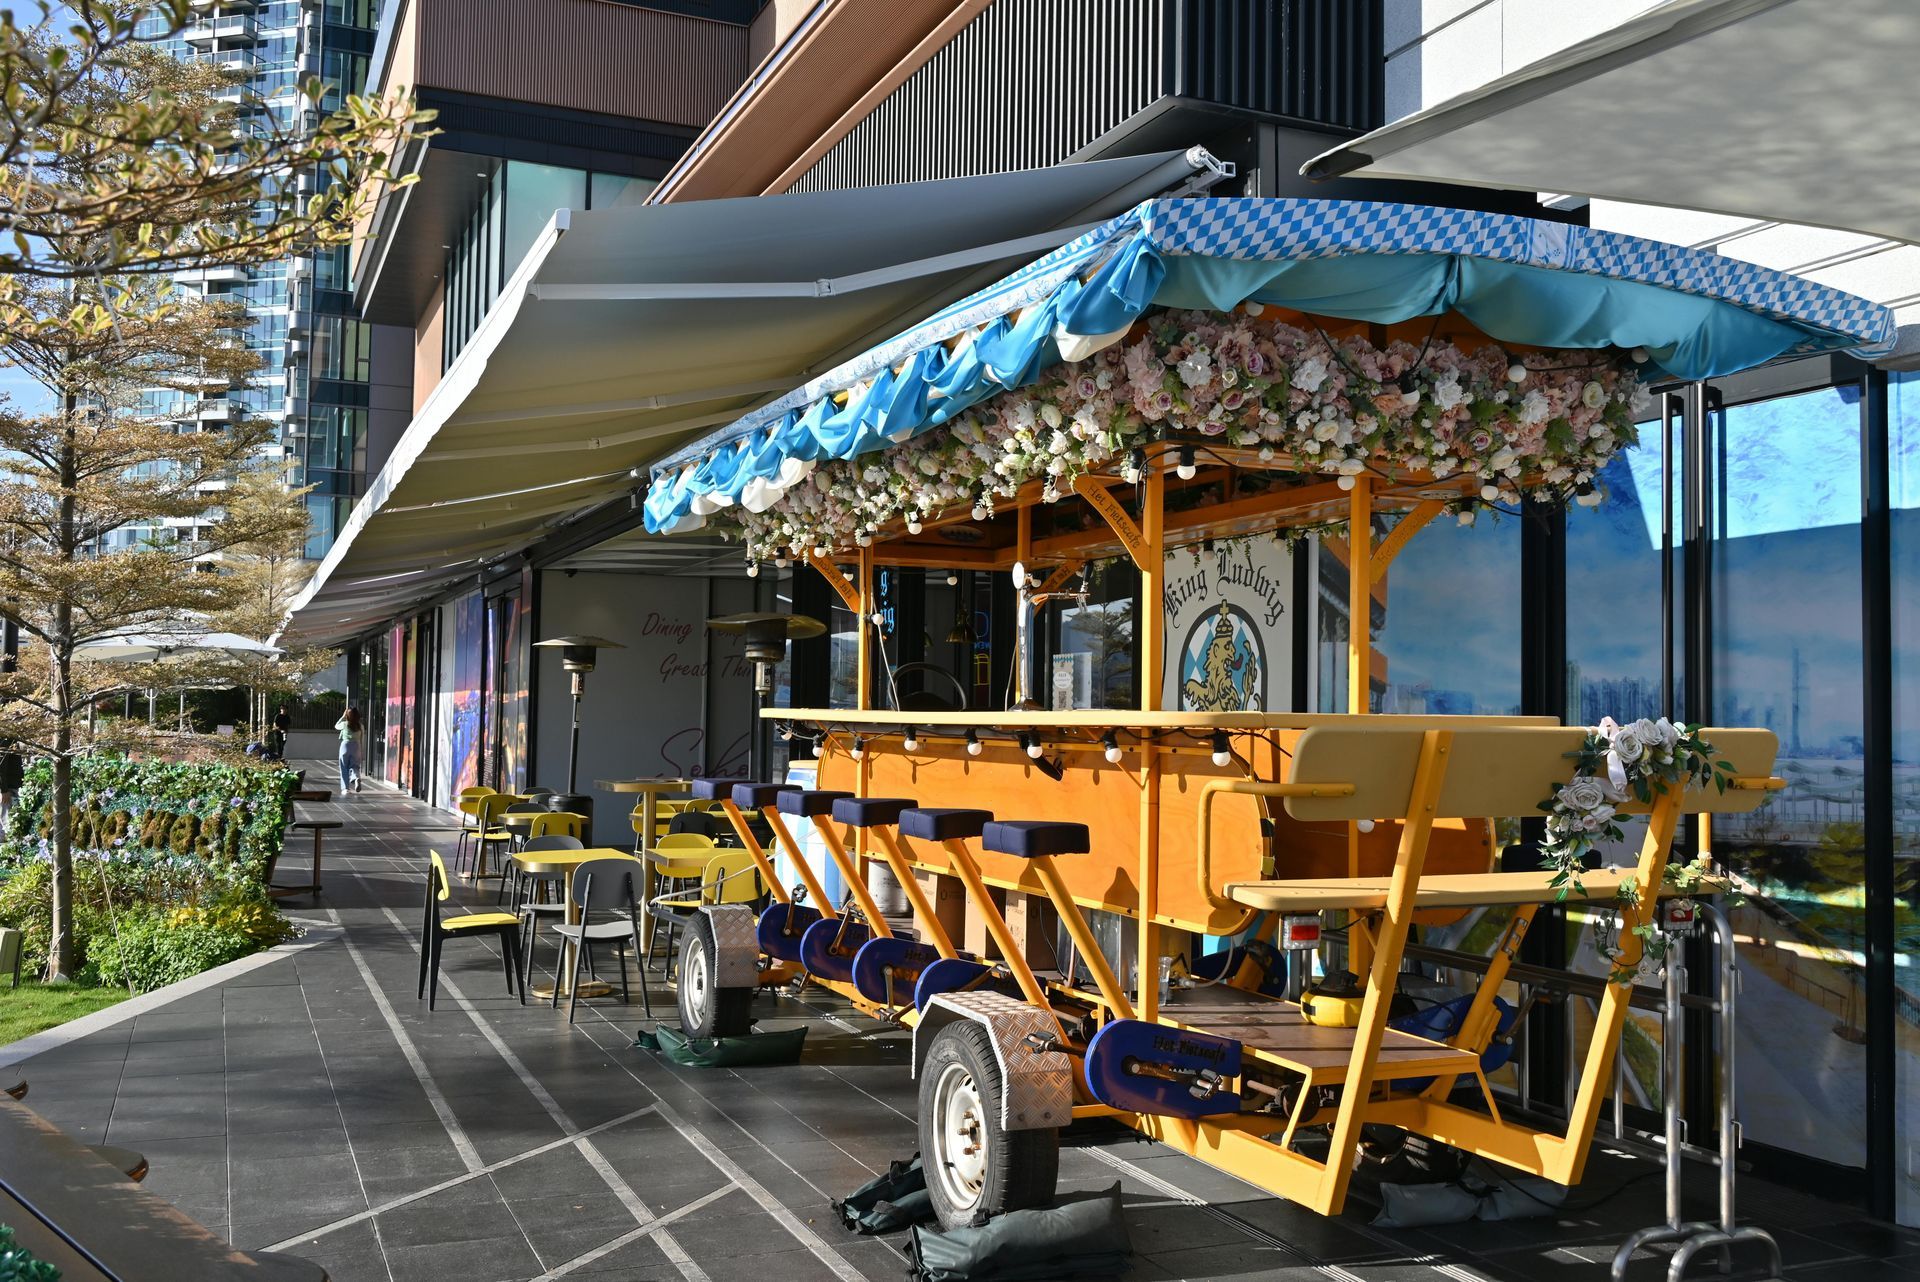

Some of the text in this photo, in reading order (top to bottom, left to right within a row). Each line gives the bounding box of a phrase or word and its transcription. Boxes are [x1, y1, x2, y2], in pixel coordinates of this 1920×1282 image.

[1165, 548, 1285, 629] King Ludwig
[642, 612, 693, 645] Dining
